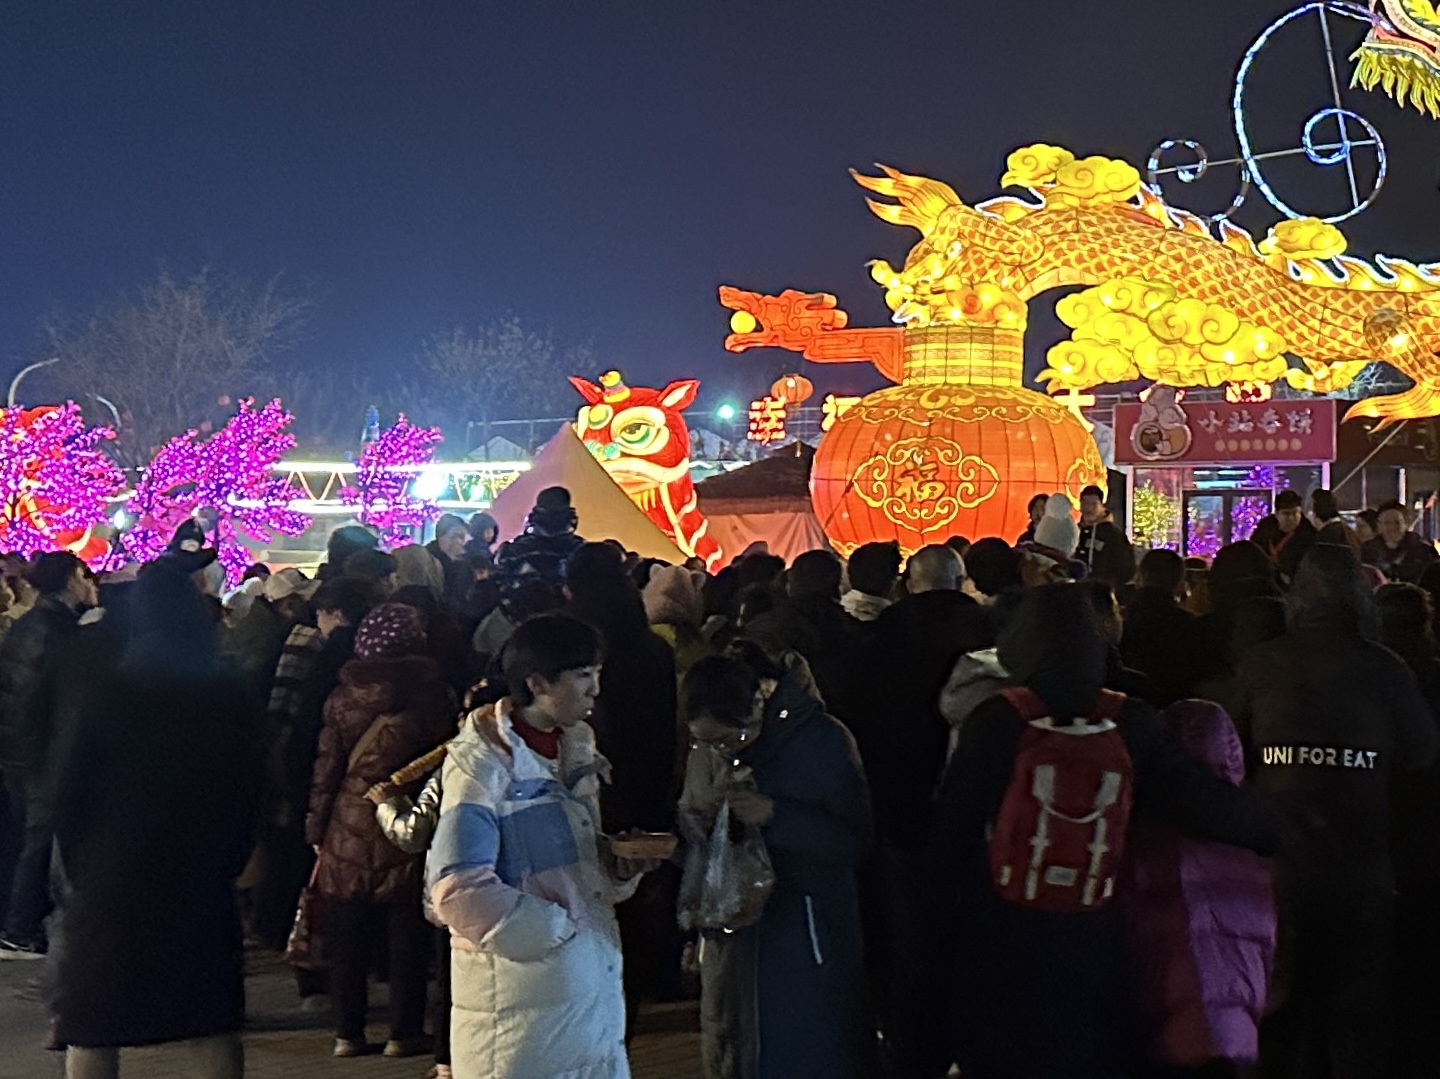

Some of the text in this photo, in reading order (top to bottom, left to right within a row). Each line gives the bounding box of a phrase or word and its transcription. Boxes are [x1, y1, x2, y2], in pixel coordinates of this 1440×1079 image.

[895, 460, 946, 503] 福
[1263, 746, 1378, 769] UNI FOR EAT
